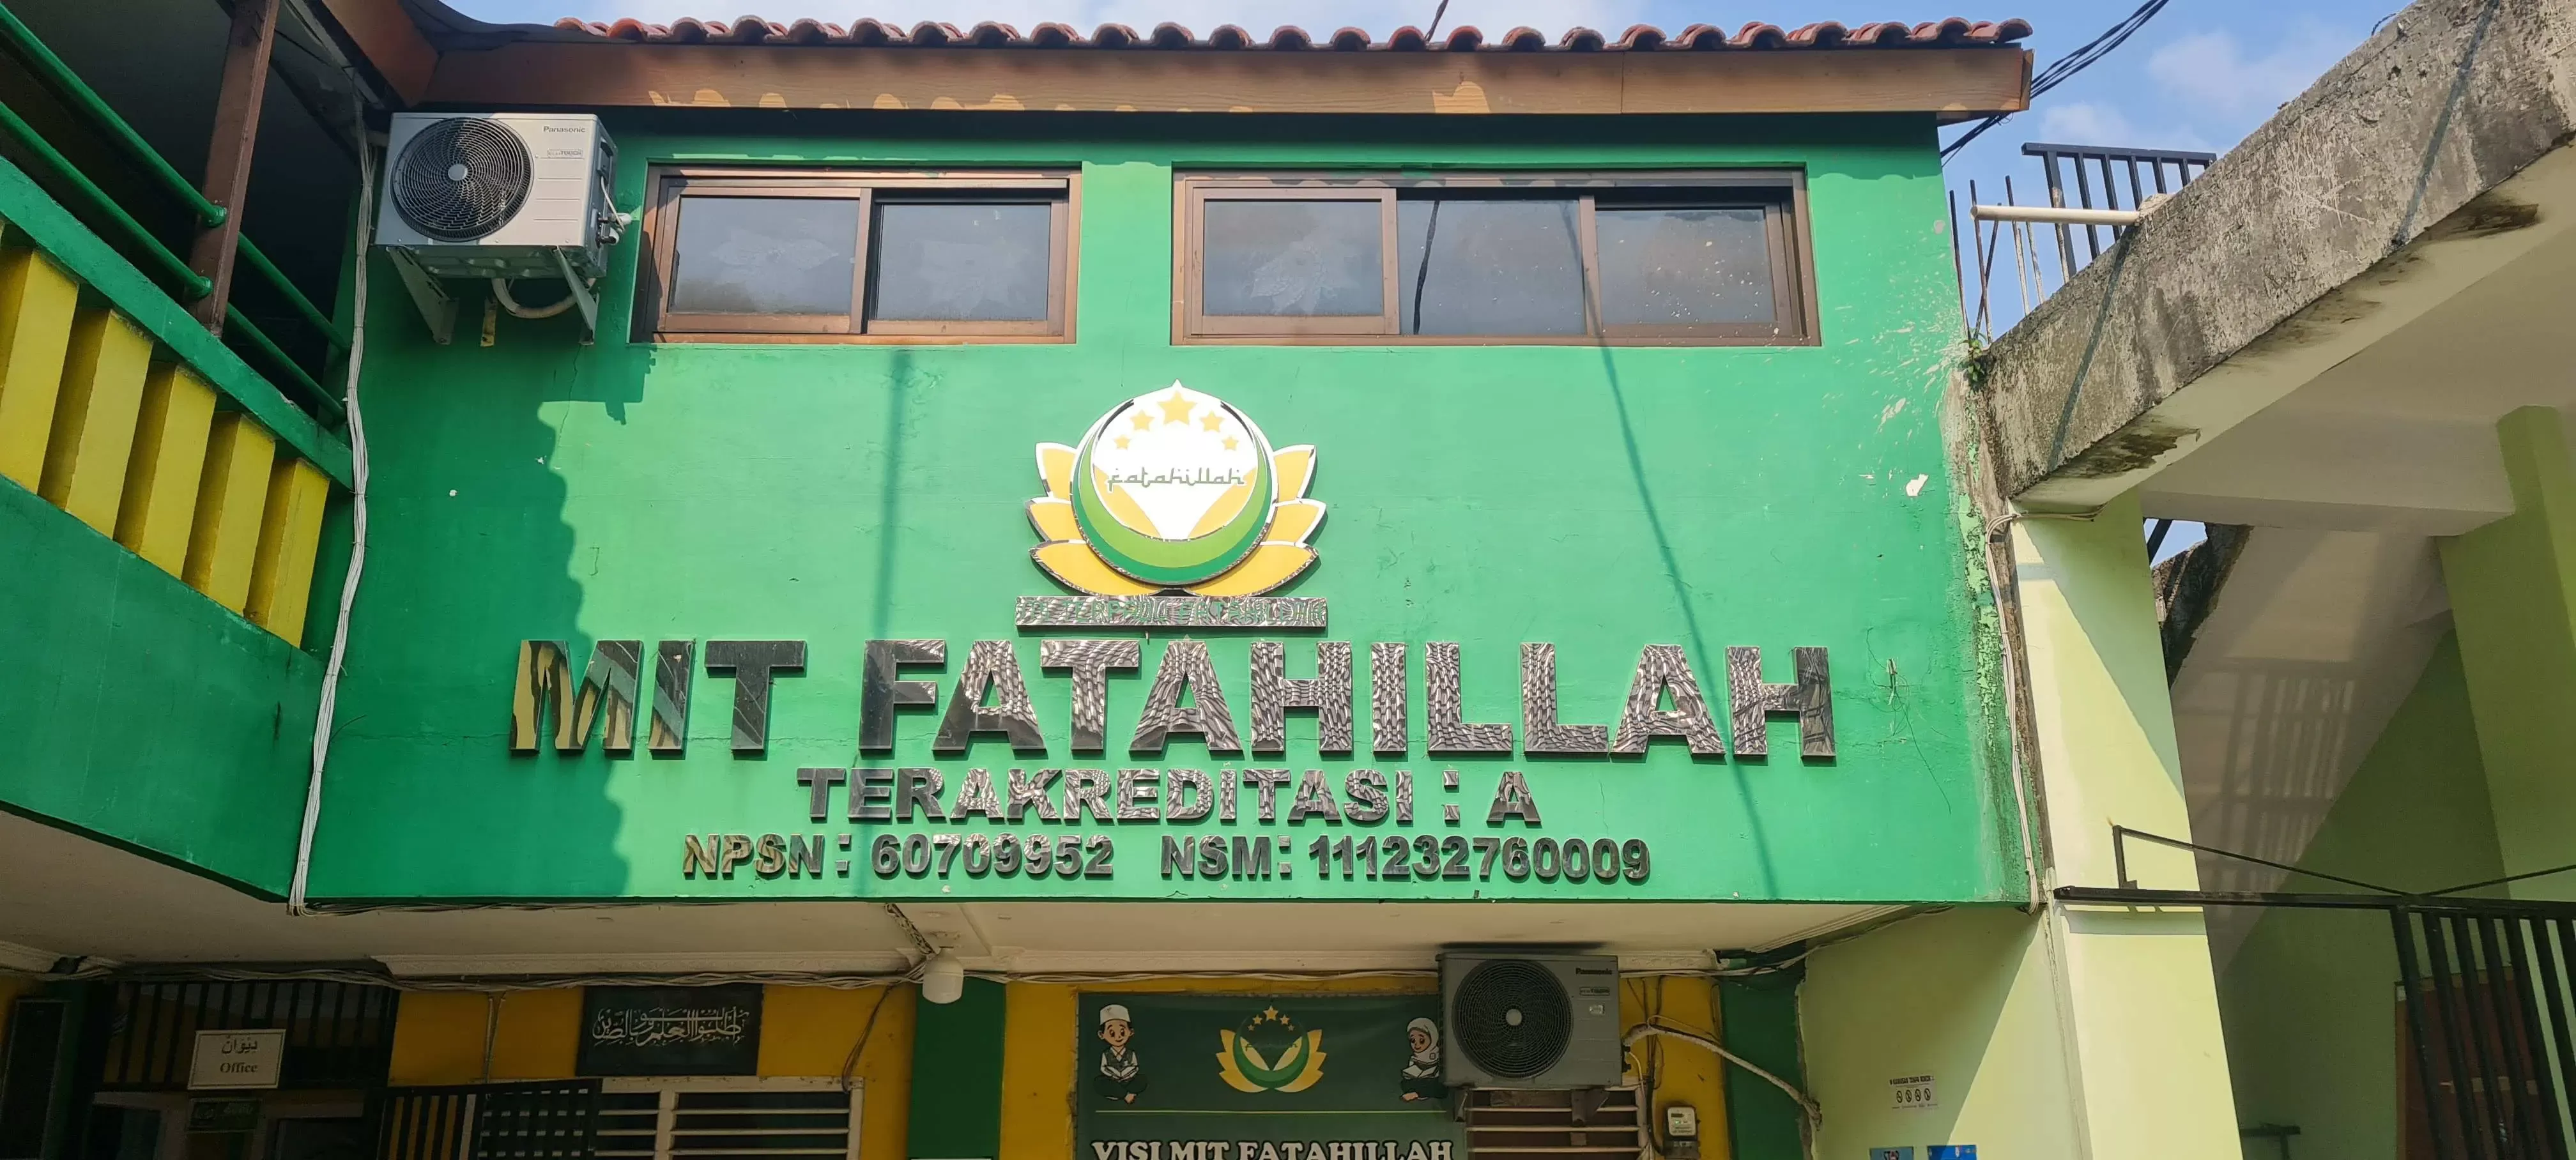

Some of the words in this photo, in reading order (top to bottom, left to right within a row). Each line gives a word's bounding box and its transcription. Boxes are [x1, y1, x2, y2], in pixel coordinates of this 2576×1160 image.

[511, 639, 806, 754] MIT
[859, 639, 1836, 760] FATAHILLAH
[797, 768, 1413, 822] TERAKREDITASI
[1486, 772, 1541, 824] A
[871, 834, 1114, 880] 60709952
[1309, 836, 1651, 884] 111232760009
[220, 1062, 258, 1073] Office
[1091, 1141, 1162, 1160] VISI
[1169, 1141, 1230, 1160] MIT
[1238, 1141, 1454, 1160] FATAHILLAH
